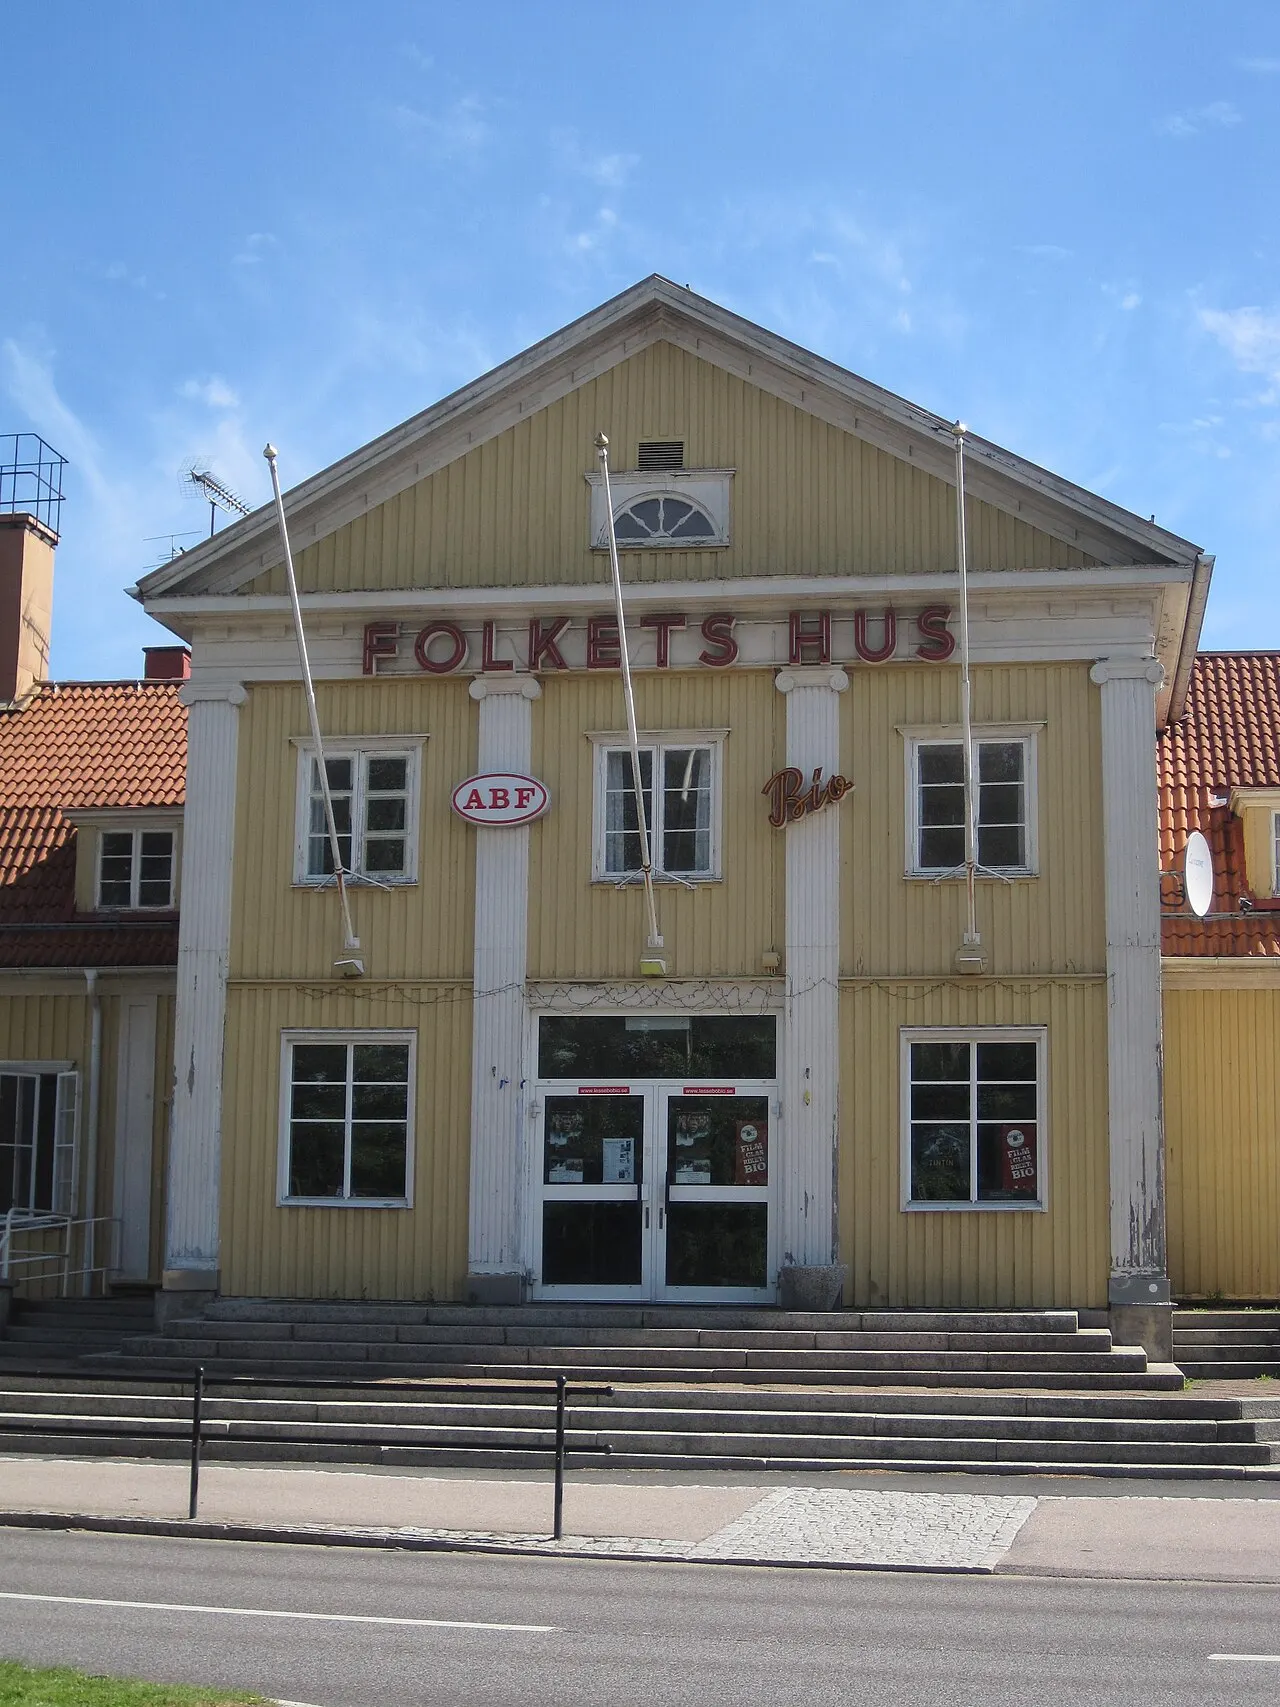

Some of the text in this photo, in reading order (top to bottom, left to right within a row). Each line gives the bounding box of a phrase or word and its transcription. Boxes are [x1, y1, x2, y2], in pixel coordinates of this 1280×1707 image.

[361, 604, 956, 676] FOLKETS HUS
[462, 786, 536, 810] ABF
[761, 765, 856, 830] Bio
[741, 1143, 762, 1152] FILM
[1008, 1148, 1030, 1158] FILM
[744, 1163, 766, 1173] BIO
[1012, 1168, 1034, 1179] BIO
